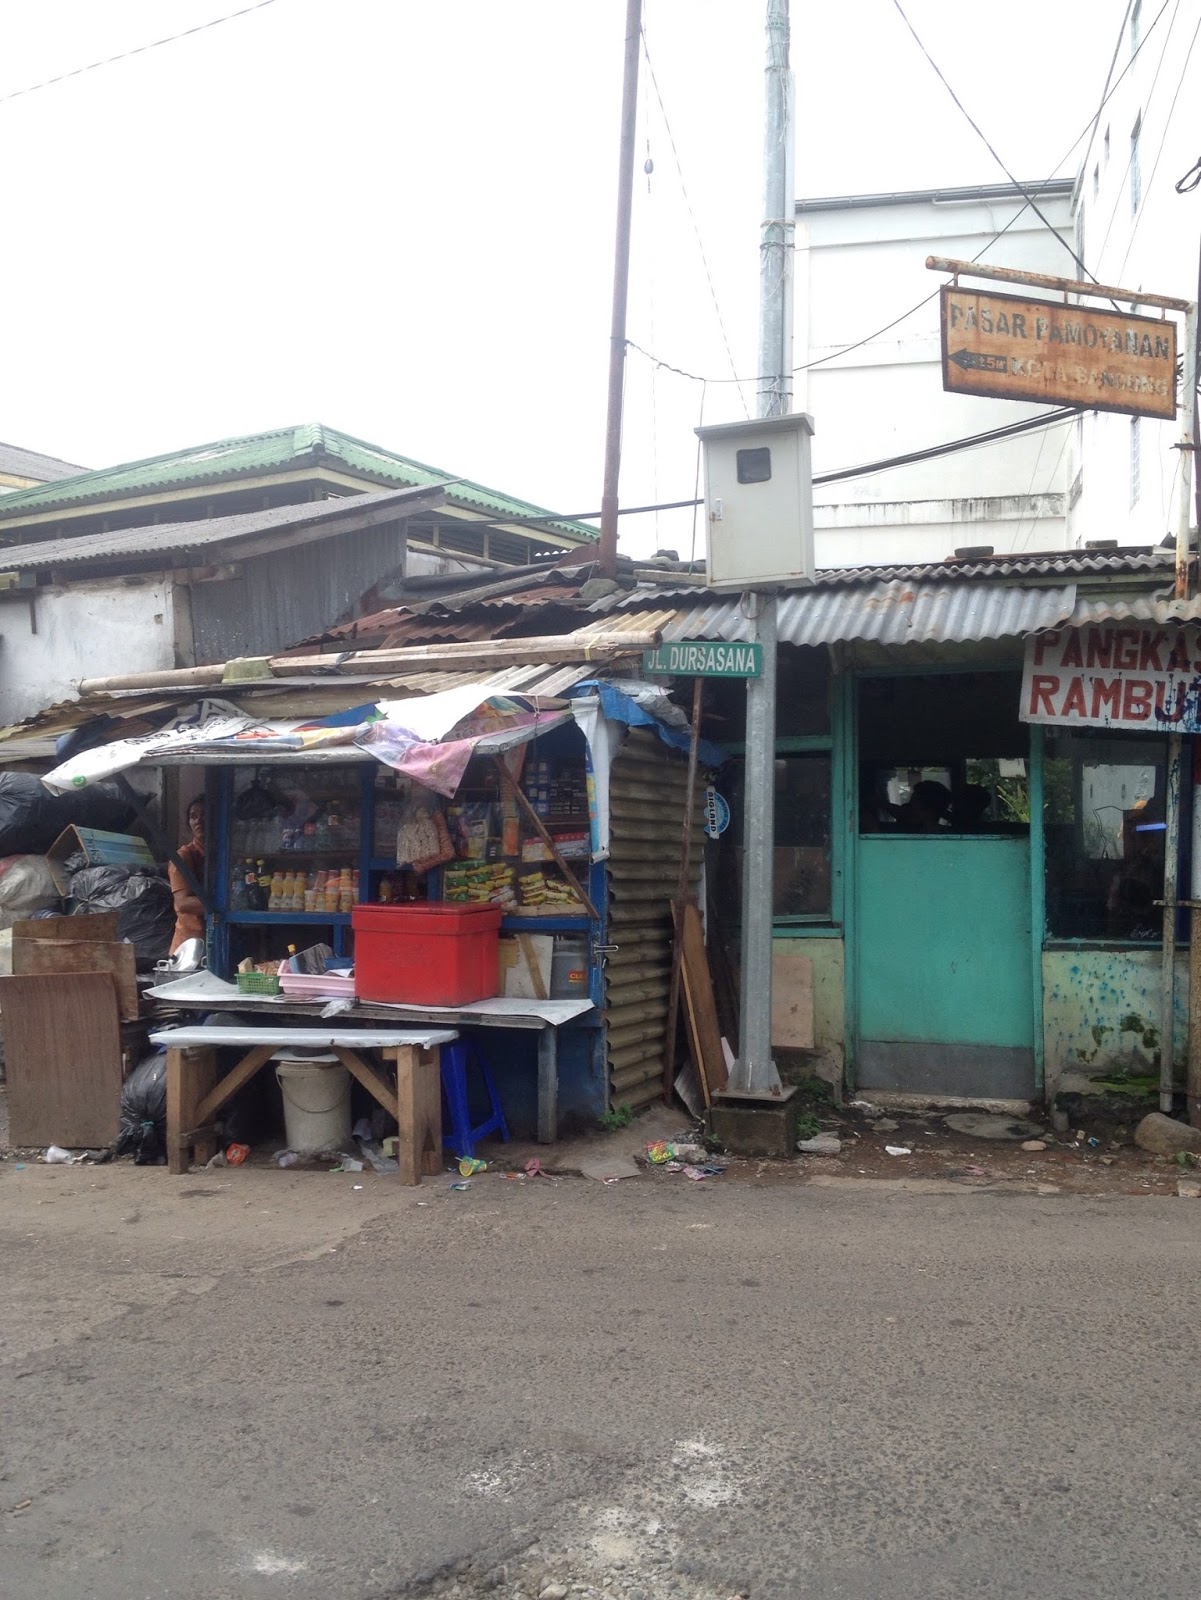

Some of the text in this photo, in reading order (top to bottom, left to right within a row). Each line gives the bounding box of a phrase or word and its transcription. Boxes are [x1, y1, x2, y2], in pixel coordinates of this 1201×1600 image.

[950, 303, 1169, 360] PASAR PAMOYANAN
[648, 646, 755, 673] JL. DURSASANA
